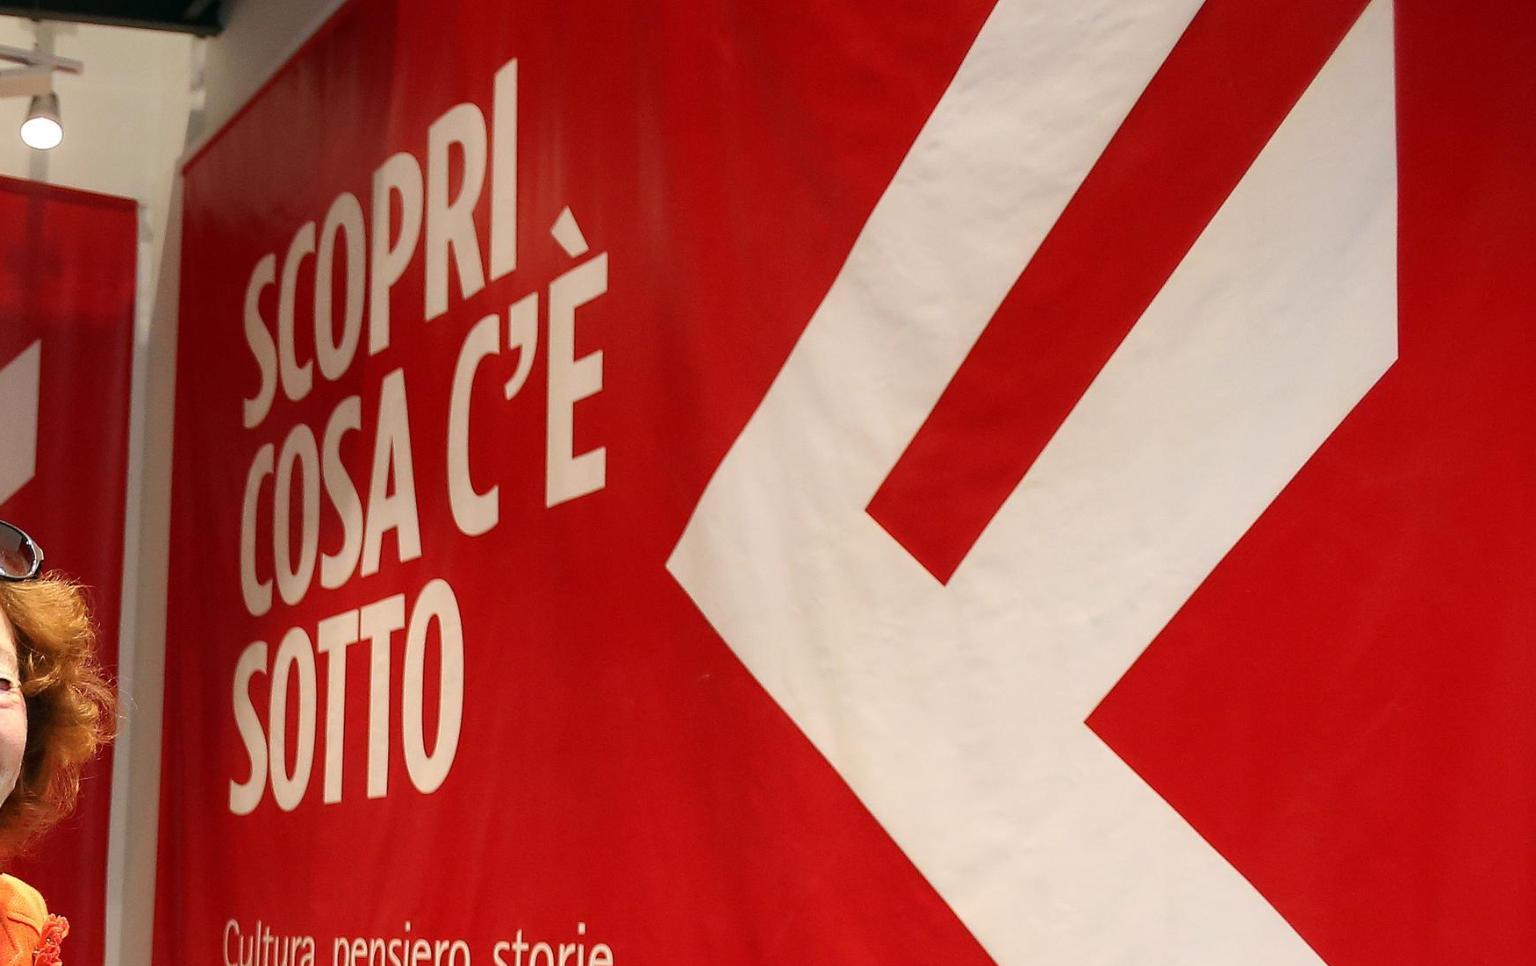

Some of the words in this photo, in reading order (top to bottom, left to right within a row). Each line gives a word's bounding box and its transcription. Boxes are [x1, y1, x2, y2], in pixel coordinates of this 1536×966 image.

[240, 367, 422, 616] COSA
[446, 205, 608, 536] C'È
[242, 57, 518, 428] SCOPRI
[228, 577, 464, 816] SOTTO
